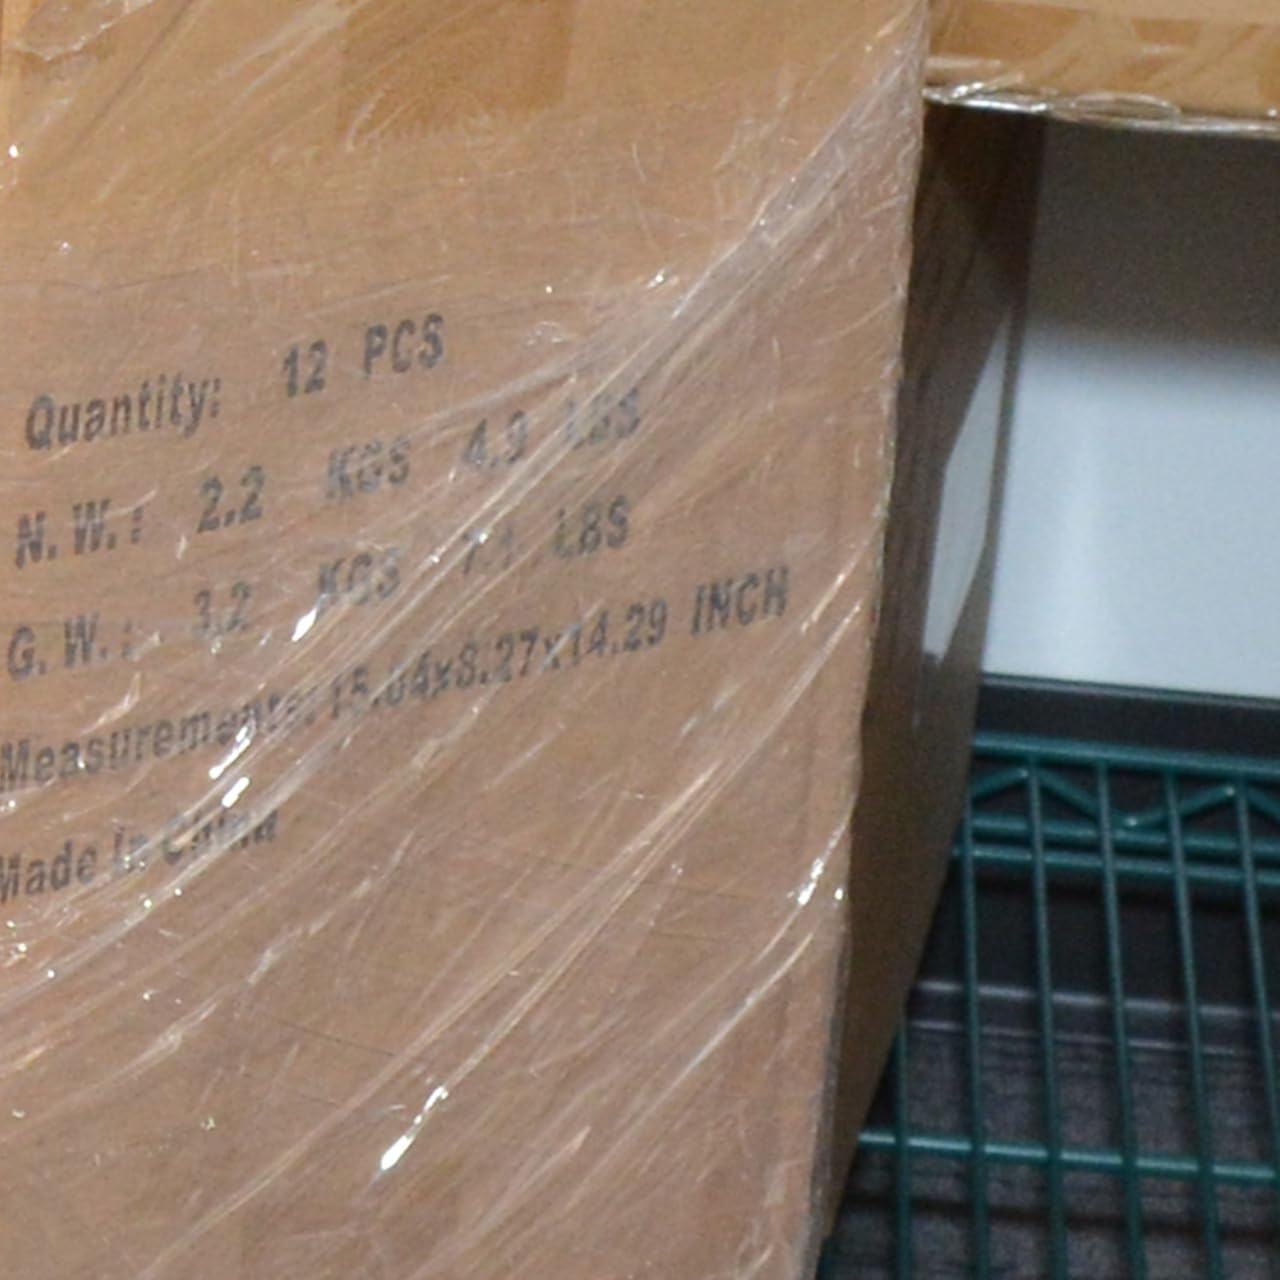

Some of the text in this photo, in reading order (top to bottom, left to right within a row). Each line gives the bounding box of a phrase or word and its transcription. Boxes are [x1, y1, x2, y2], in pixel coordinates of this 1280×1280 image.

[24, 313, 444, 451] Quantity: 12 PCS
[196, 465, 265, 534] 2.2
[325, 436, 412, 500] KGS
[464, 409, 529, 467] 4.9
[553, 494, 629, 559] LBS
[690, 566, 791, 637] INCH
